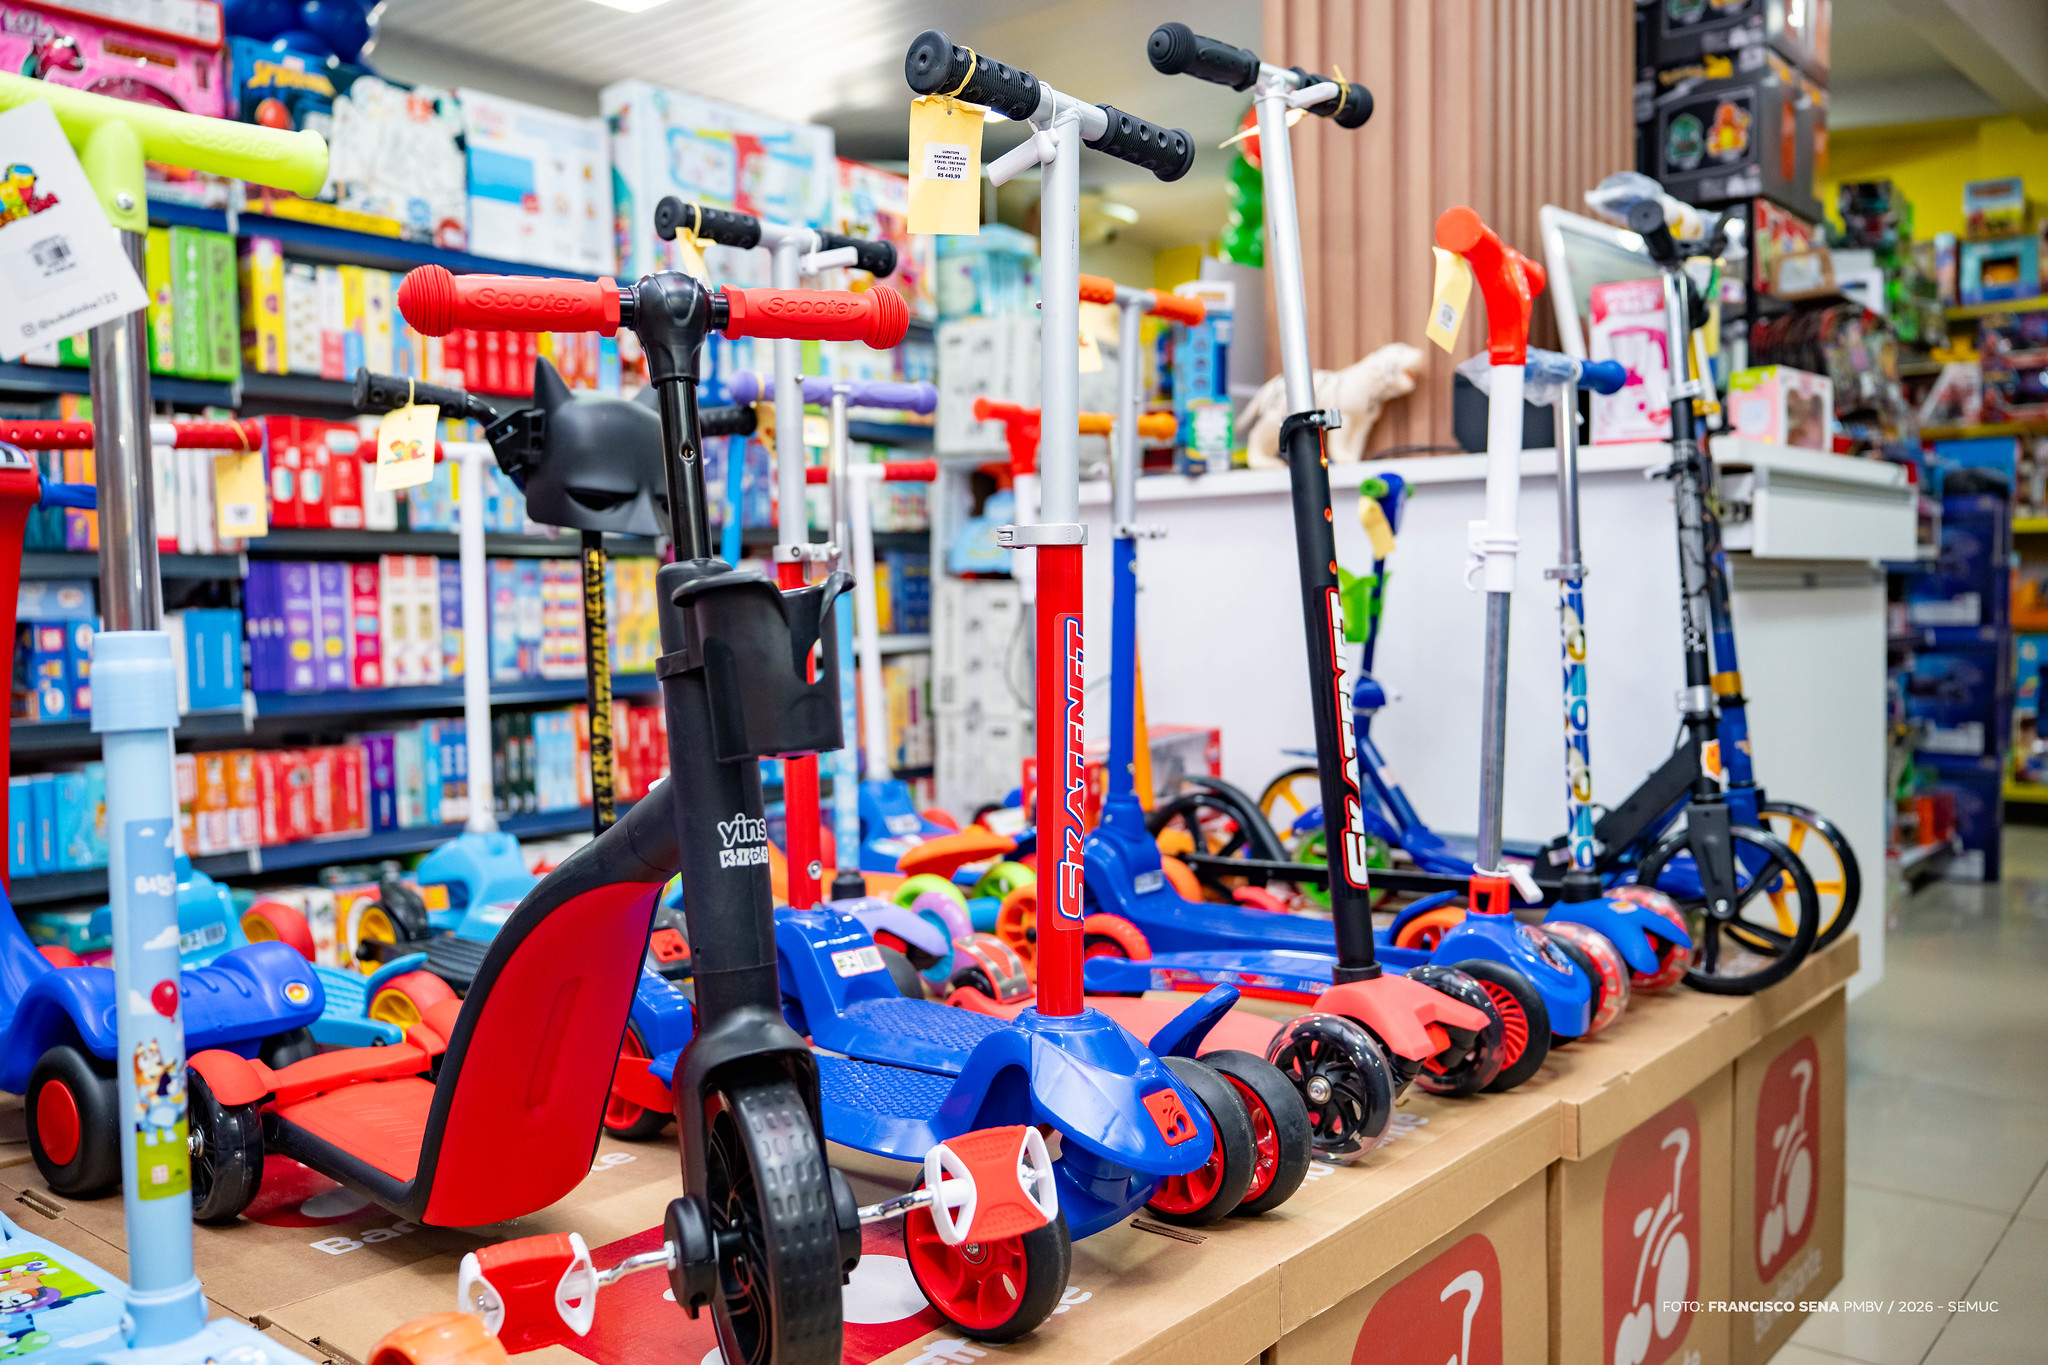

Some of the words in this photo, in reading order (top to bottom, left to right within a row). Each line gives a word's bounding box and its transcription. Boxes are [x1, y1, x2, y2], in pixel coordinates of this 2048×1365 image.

[475, 287, 582, 313] Scooter
[767, 297, 859, 316] Scooter
[717, 812, 768, 848] yins
[719, 846, 769, 868] KIDS
